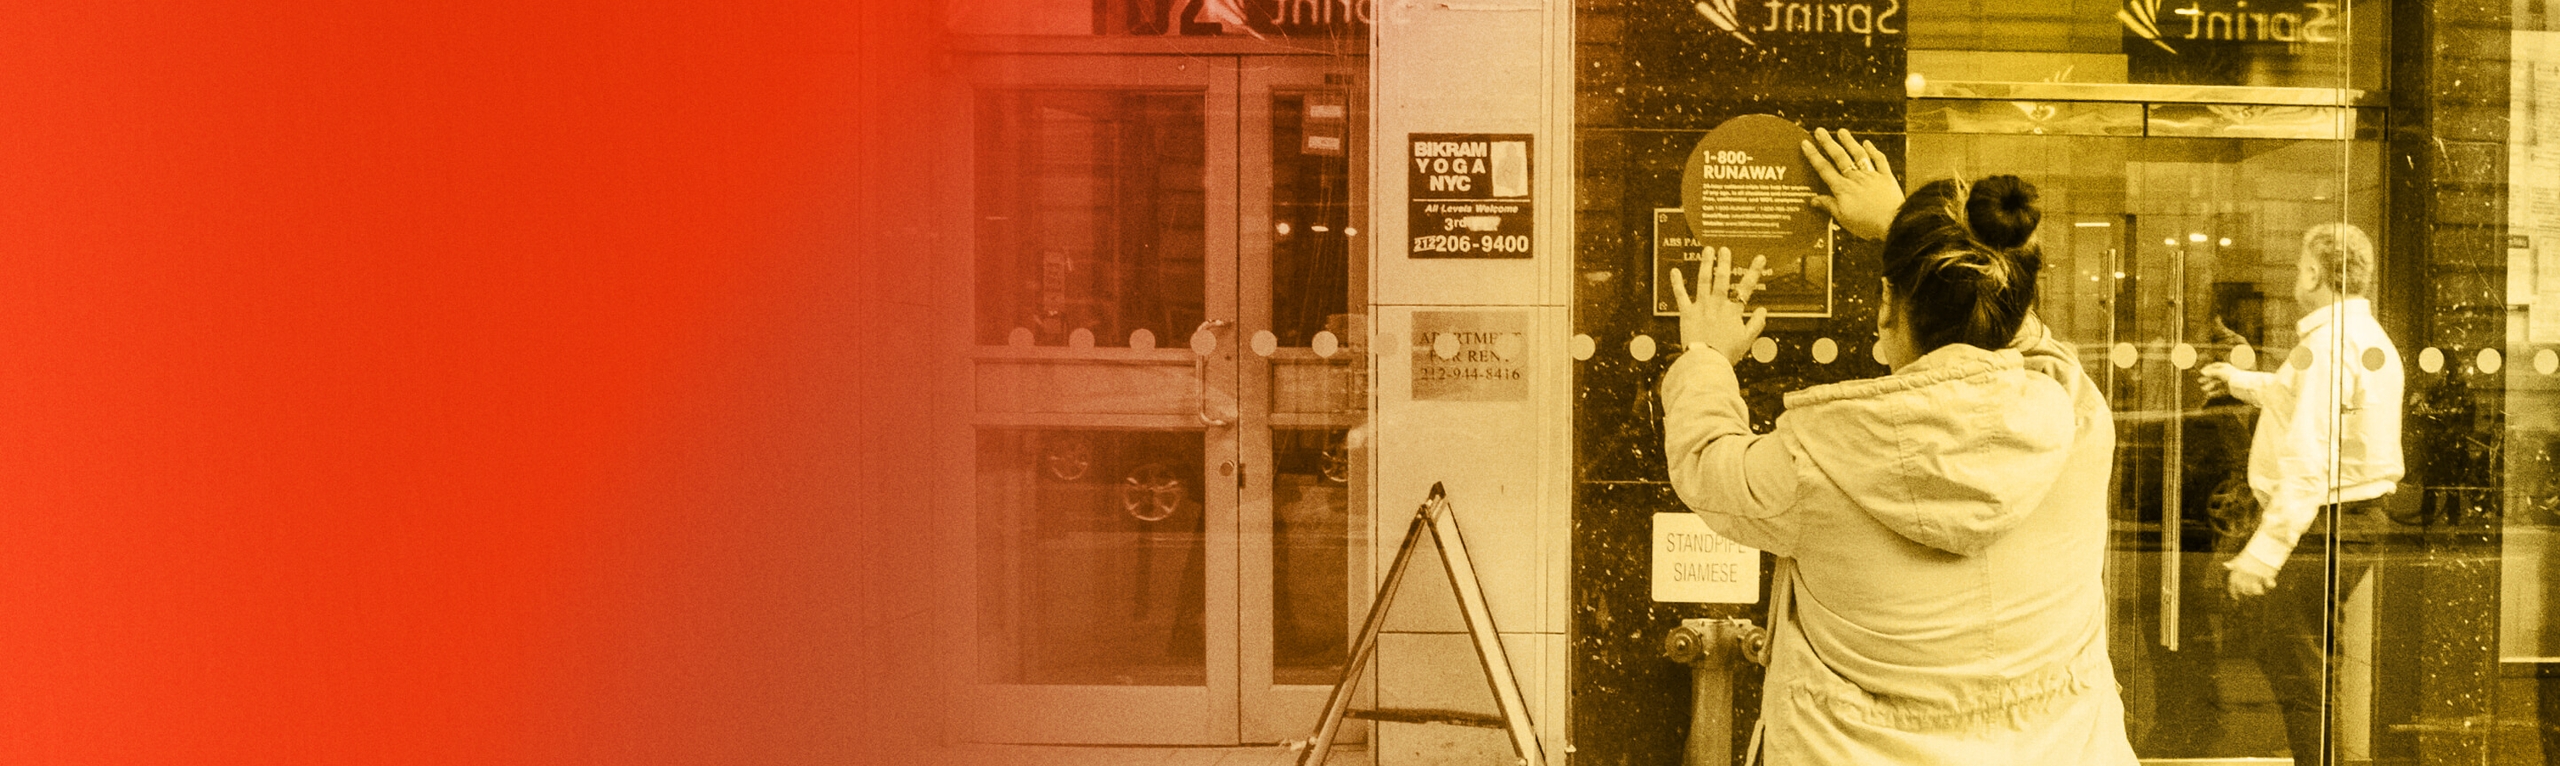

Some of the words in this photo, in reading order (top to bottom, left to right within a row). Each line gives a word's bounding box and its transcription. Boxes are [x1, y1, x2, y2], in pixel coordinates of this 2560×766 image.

[1414, 141, 1487, 157] BIKRAM
[1703, 150, 1754, 164] 1-800-
[1415, 158, 1486, 174] YOGA
[1703, 165, 1787, 180] RUNAWAY
[1429, 175, 1471, 191] NYC
[1425, 204, 1439, 213] All
[1441, 204, 1472, 213] Levels
[1475, 205, 1519, 213] Welcome
[1435, 235, 1529, 252] 206-9400
[1663, 238, 1682, 247] ABS
[1429, 349, 1462, 362] FR
[1468, 350, 1510, 362] REN
[1674, 562, 1738, 583] SIAMESE
